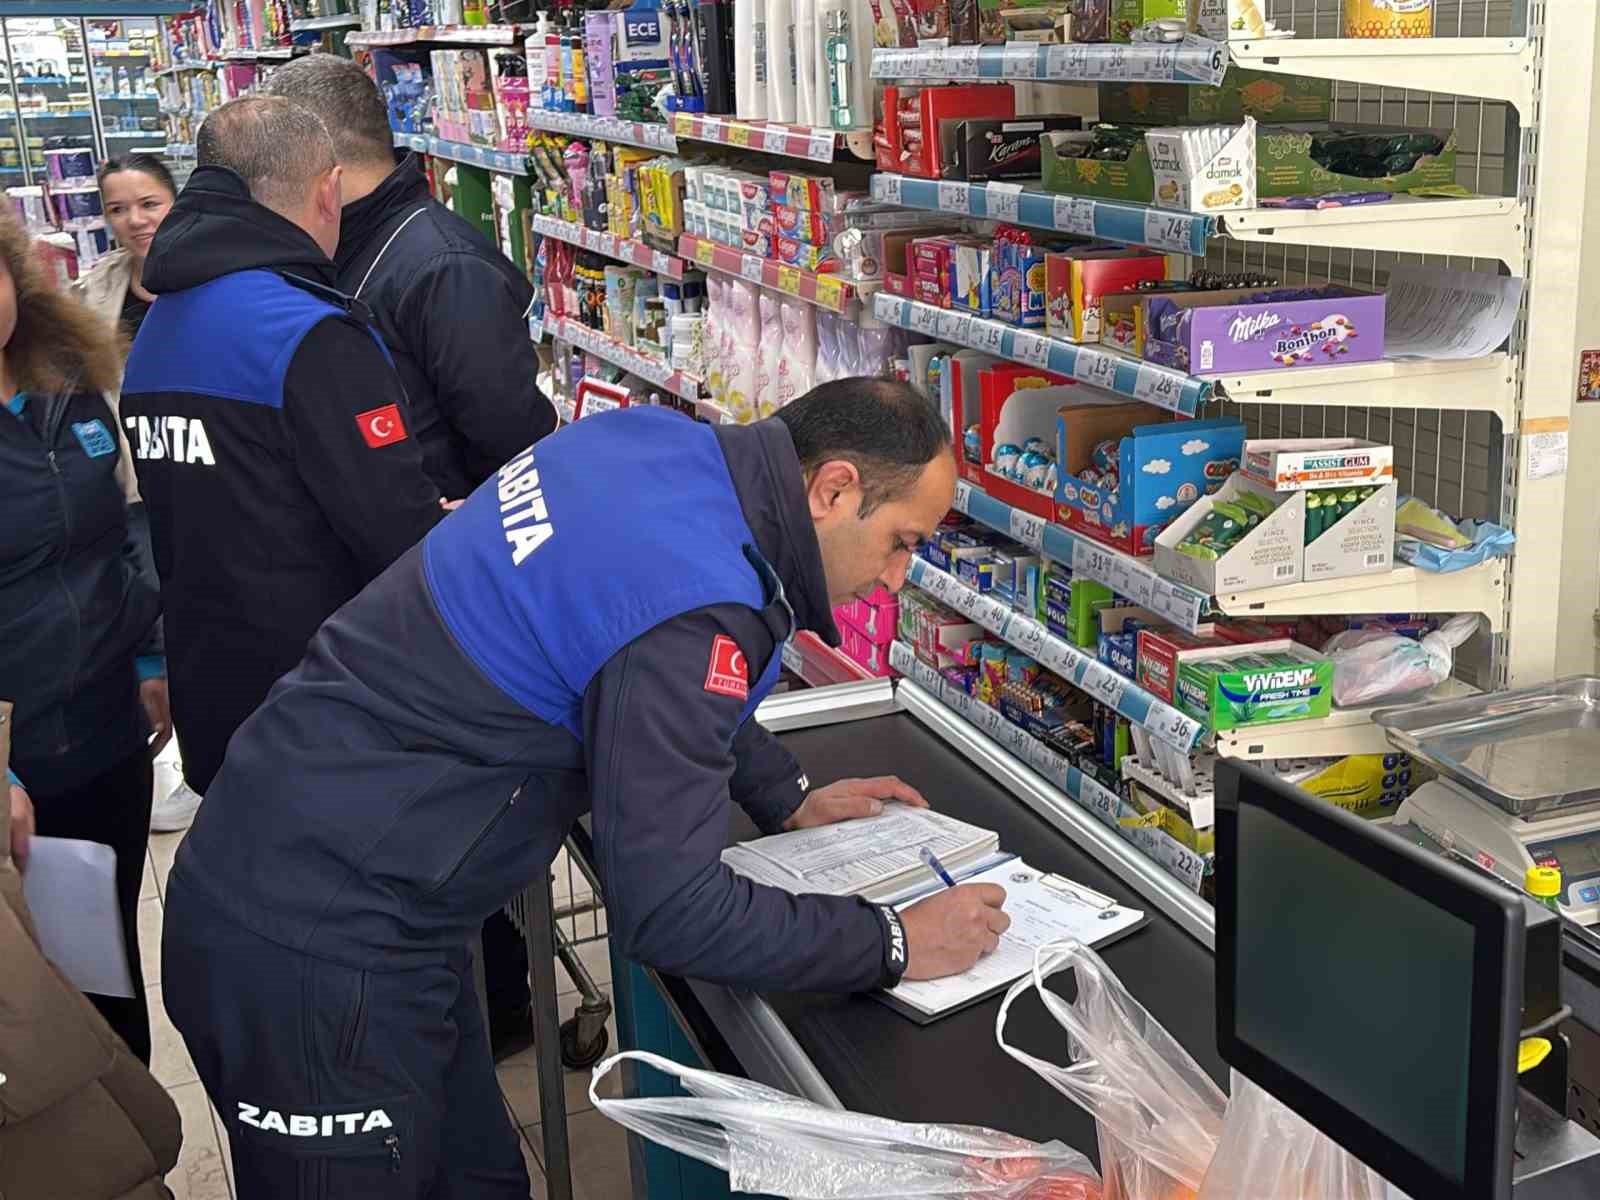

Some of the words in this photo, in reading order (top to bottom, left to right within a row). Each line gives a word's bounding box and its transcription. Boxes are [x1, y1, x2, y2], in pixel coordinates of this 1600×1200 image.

[628, 23, 658, 37] ECE
[1206, 162, 1242, 179] damak
[1166, 218, 1182, 239] 74
[1228, 311, 1280, 342] Milka
[1276, 326, 1336, 353] Bonibon
[1156, 375, 1172, 395] 28
[1047, 607, 1066, 625] POLO
[1171, 716, 1188, 737] 36
[1096, 791, 1110, 812] 28
[1177, 851, 1192, 874] 22
[238, 1101, 393, 1137] ZABITA
